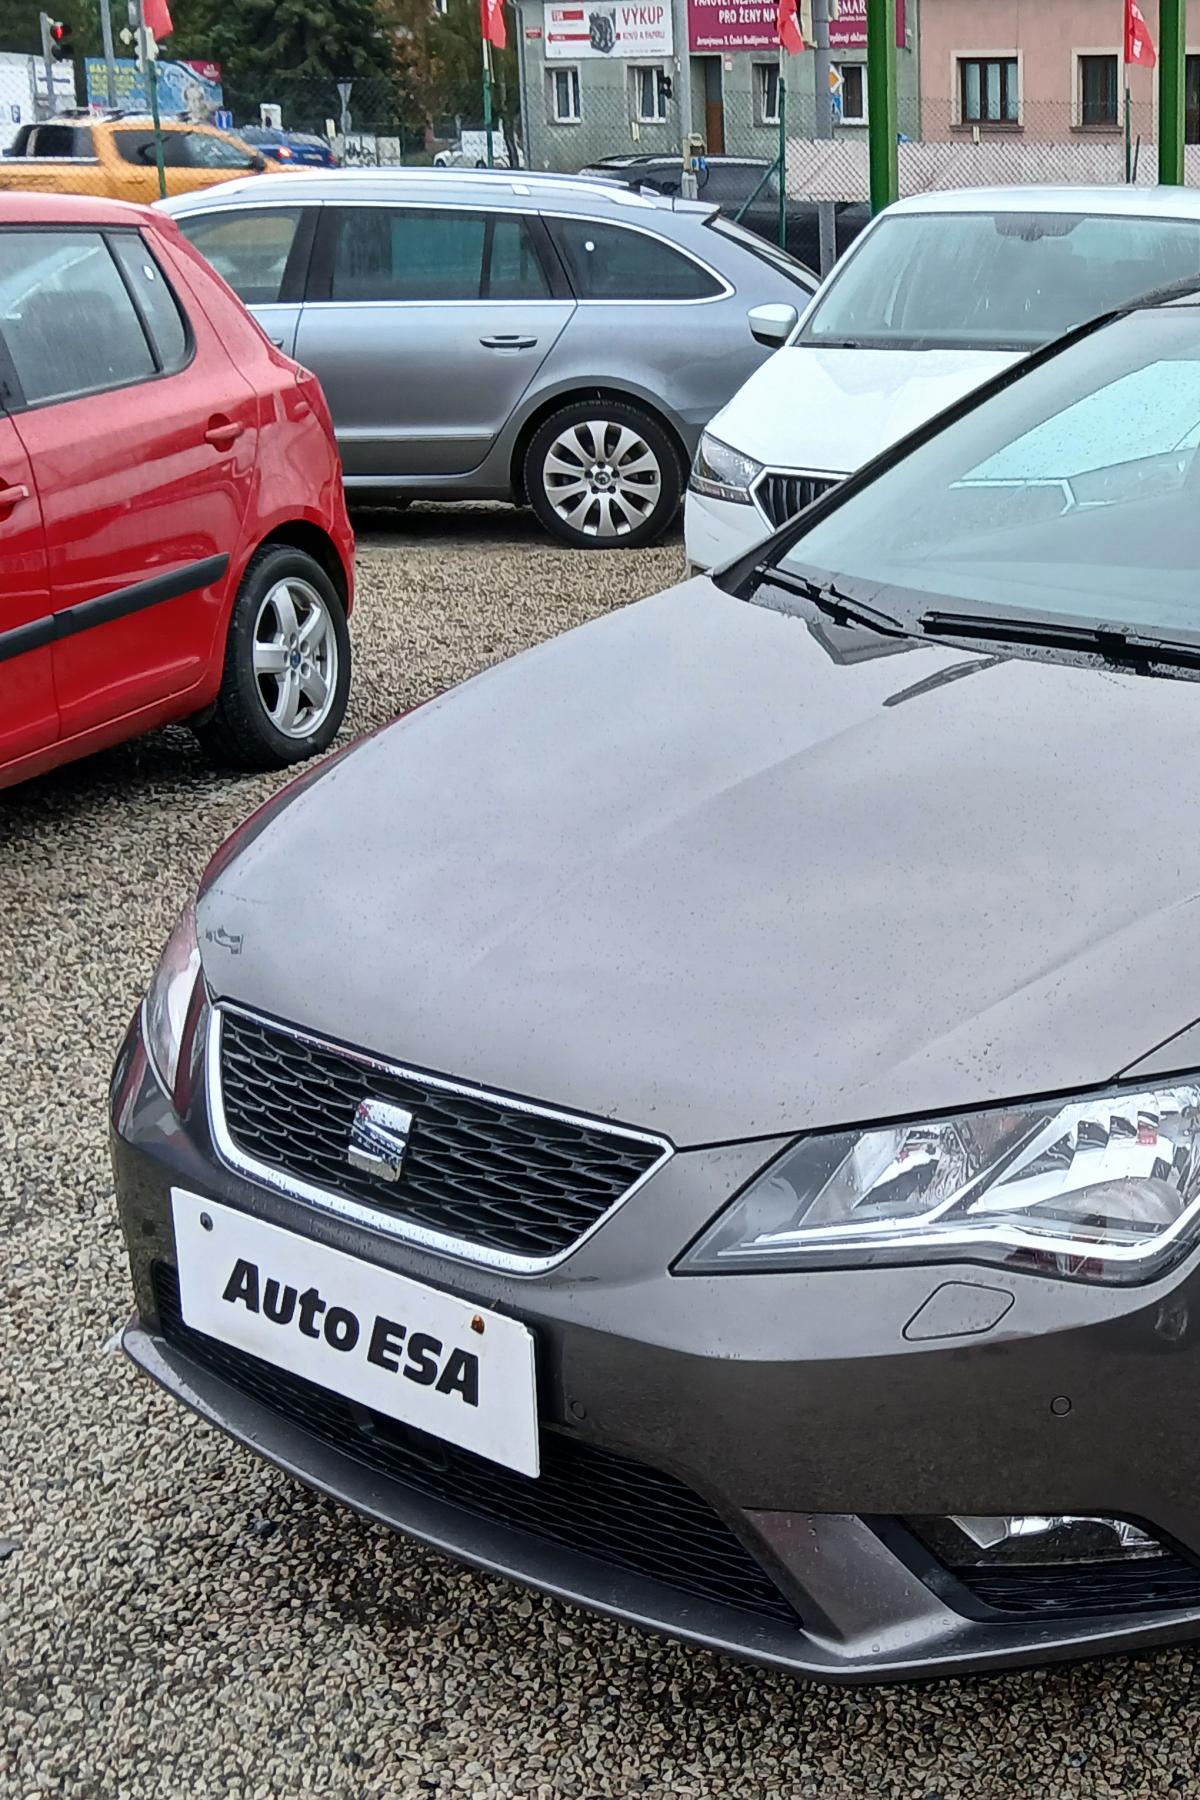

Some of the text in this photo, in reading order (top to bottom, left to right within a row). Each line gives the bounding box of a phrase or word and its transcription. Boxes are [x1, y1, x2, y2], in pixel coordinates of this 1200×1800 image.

[622, 4, 663, 26] VÝKUP
[719, 9, 737, 24] PRO
[739, 6, 761, 23] ŽENY
[763, 8, 776, 23] NA
[222, 1257, 480, 1408] Auto ESA
